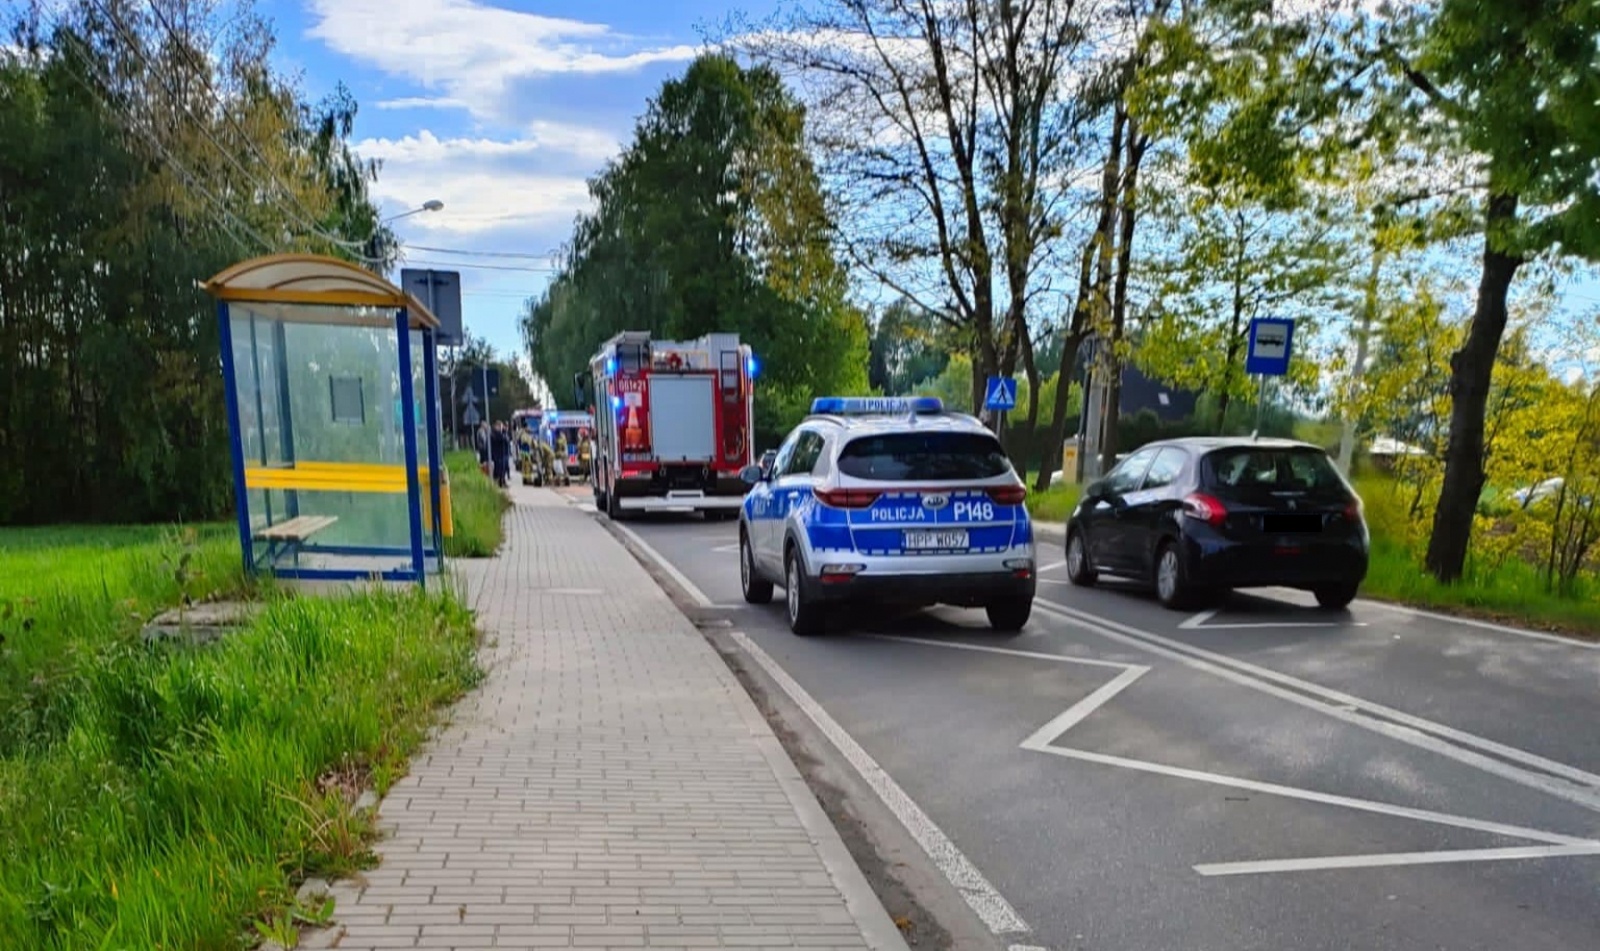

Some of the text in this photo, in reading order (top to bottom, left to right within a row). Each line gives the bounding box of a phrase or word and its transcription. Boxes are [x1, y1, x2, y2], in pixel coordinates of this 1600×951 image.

[871, 506, 925, 521] POLICJA
[953, 501, 994, 521] P148
[908, 532, 932, 547] HPP
